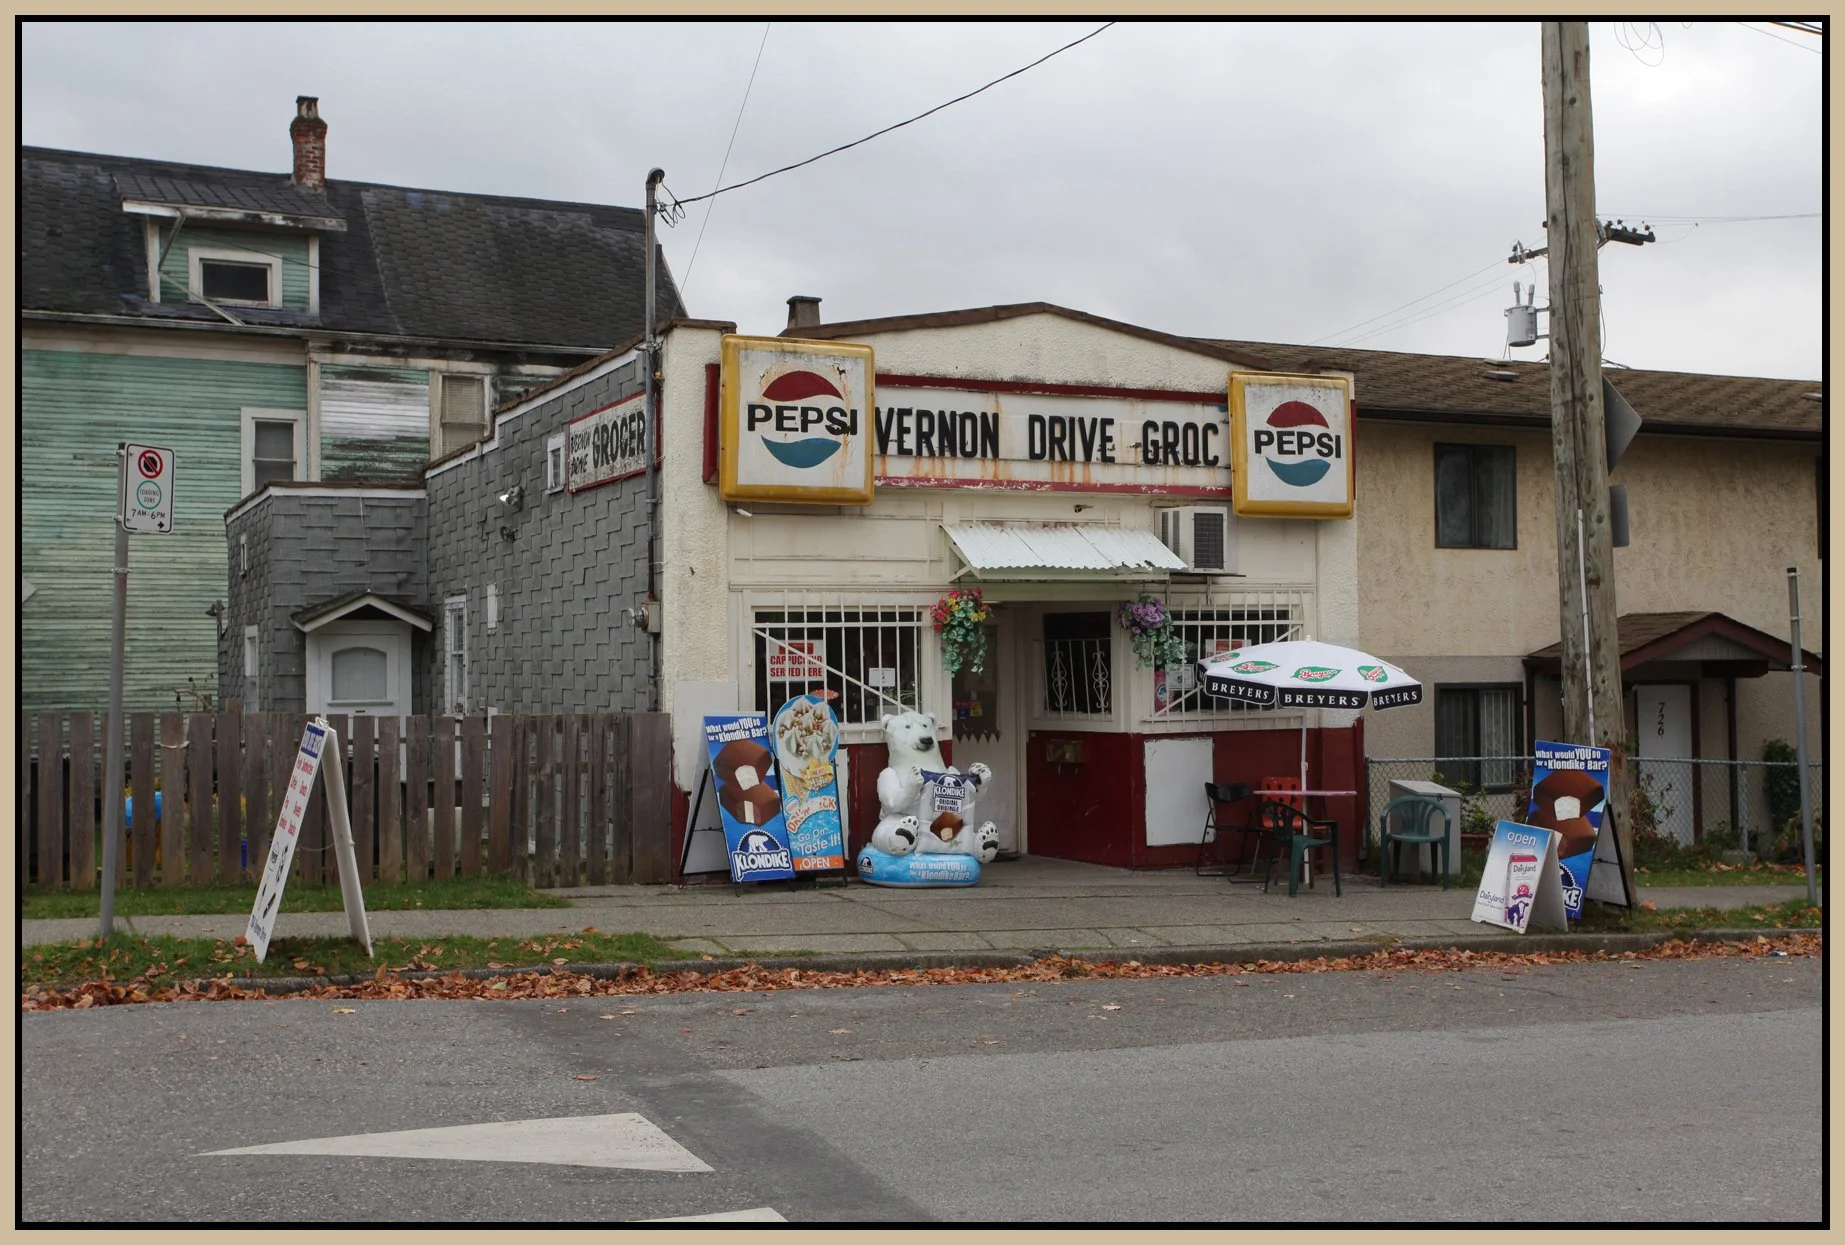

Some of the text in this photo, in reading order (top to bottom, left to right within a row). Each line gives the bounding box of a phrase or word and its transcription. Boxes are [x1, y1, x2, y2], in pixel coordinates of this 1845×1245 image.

[748, 404, 857, 435] PEPSI
[875, 407, 1219, 467] VERNON DRIVE GROC
[1254, 430, 1341, 458] PEPSI
[1212, 682, 1269, 700] BREYERS
[1283, 694, 1360, 706] BREYERS
[1373, 691, 1418, 706] BREYERS
[706, 725, 721, 733] What
[723, 722, 740, 731] would
[739, 717, 753, 729] YOU
[719, 730, 750, 742] Klondike
[751, 727, 767, 738] Bar?
[1535, 750, 1553, 759] What
[1555, 750, 1575, 759] would
[1575, 748, 1592, 760] YOU
[1548, 759, 1585, 770] Klondike
[1587, 760, 1607, 770] Bar?
[934, 786, 965, 798] KLONDIKE
[798, 833, 810, 842] Go
[830, 833, 841, 846] It!
[1507, 832, 1536, 846] open
[734, 851, 790, 879] KLONDIKE
[802, 857, 830, 869] OPEN
[1513, 864, 1536, 875] Dairyland
[1480, 891, 1504, 903] Dairyland
